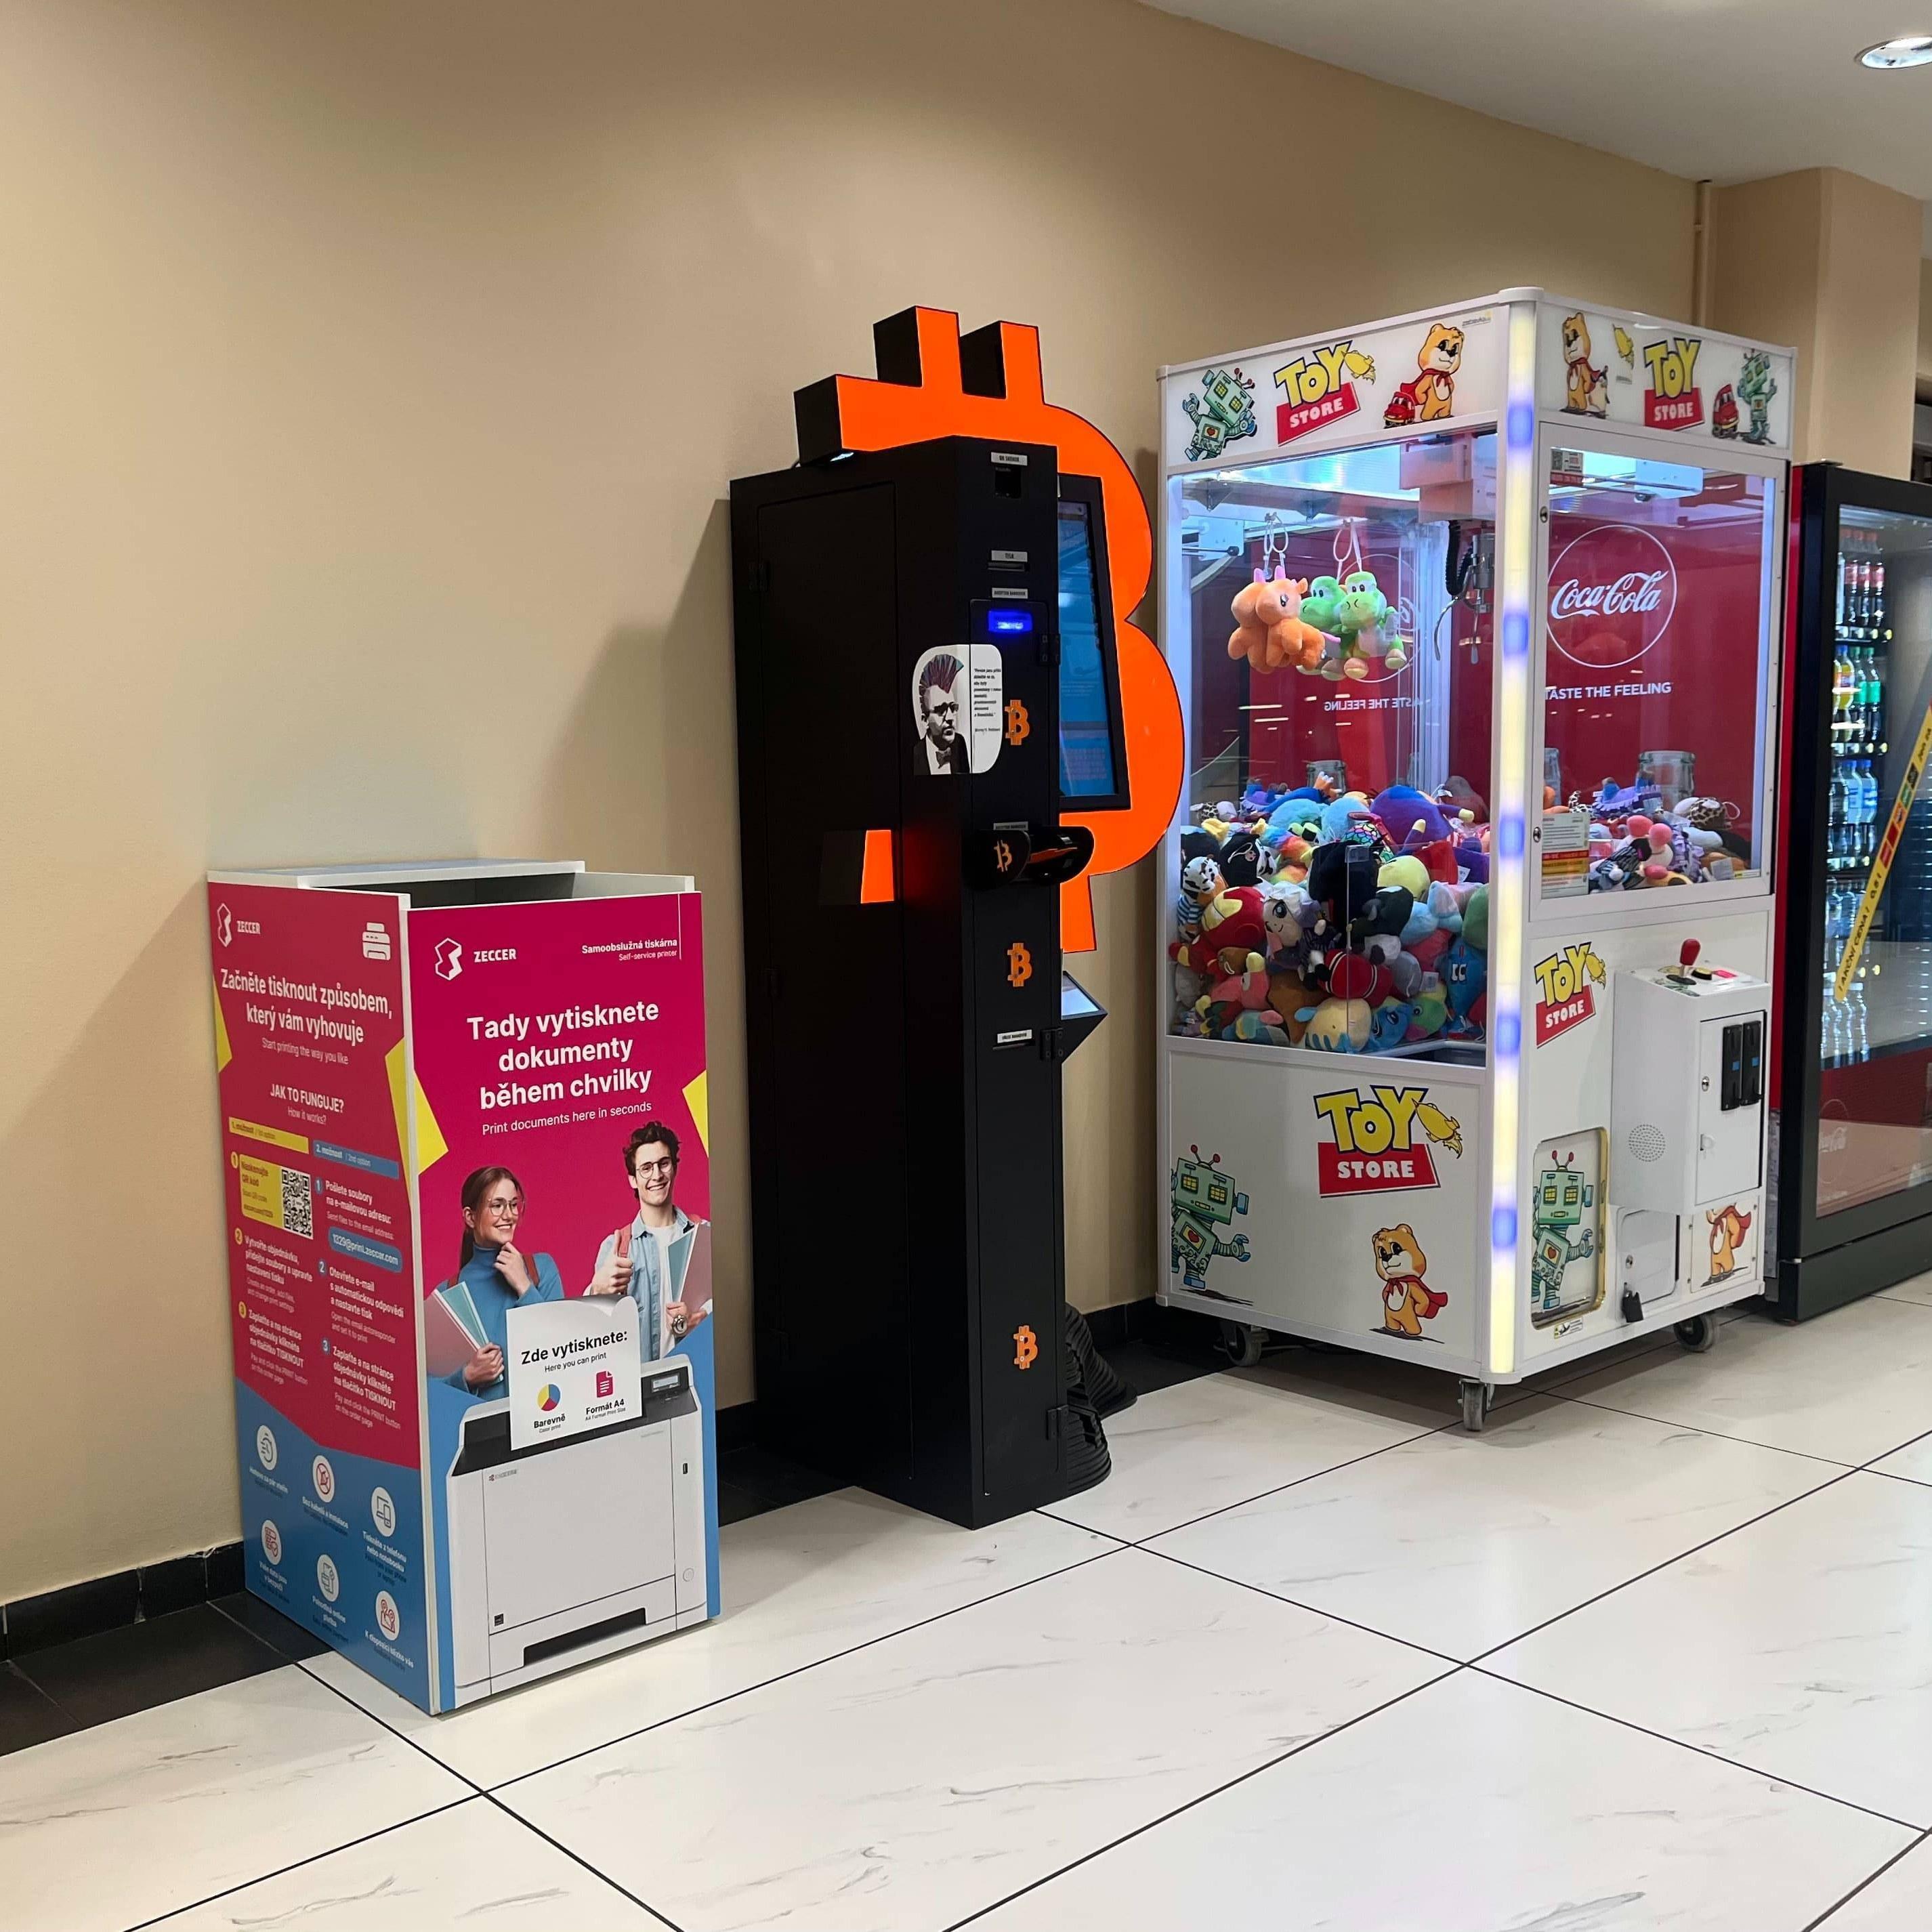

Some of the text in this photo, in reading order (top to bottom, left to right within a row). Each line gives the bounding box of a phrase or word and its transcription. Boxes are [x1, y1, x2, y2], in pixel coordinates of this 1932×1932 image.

[1289, 397, 1344, 429] STORE
[1654, 402, 1694, 423] STORE
[1551, 570, 1670, 619] Coca-Cola
[1585, 686, 1611, 698] THE
[1614, 681, 1672, 696] FEELING
[236, 920, 260, 934] ZECCER
[474, 948, 517, 963] ZECCER
[582, 938, 678, 954] Samoobslužná tiskárna
[618, 949, 678, 962] Self-service printer
[220, 968, 392, 1020] Začněte tisknout způsobem,
[466, 1001, 660, 1042] Tady vytisknete
[1545, 1000, 1584, 1028] STORE
[246, 1002, 364, 1049] který vám vyhovuje
[276, 1041, 299, 1056] printing
[299, 1045, 310, 1059] the
[310, 1048, 324, 1062] way
[324, 1051, 335, 1064] you
[337, 1053, 349, 1067] like
[499, 1036, 633, 1072] dokumenty
[270, 1083, 344, 1114] JAK TO FUNGUJE?
[480, 1067, 653, 1110] během chvilky
[287, 1106, 301, 1120] How
[482, 1101, 652, 1136] Print documents here in seconds
[1337, 1160, 1415, 1179] STORE
[348, 1185, 373, 1205] soubory
[326, 1195, 334, 1206] na
[334, 1198, 367, 1217] e-mailovou
[319, 1261, 324, 1274] 2
[355, 1275, 374, 1292] e-mail
[331, 1295, 334, 1305] a
[361, 1307, 373, 1320] tisk
[322, 1339, 328, 1351] 3
[521, 1330, 628, 1365] Zde vytisknete:
[357, 1356, 361, 1368] a
[362, 1358, 370, 1372] na
[545, 1352, 607, 1373] Here you can print
[364, 1387, 396, 1411] TISKNOUT
[585, 1398, 625, 1415] Formát A4
[533, 1413, 566, 1429] Barevně
